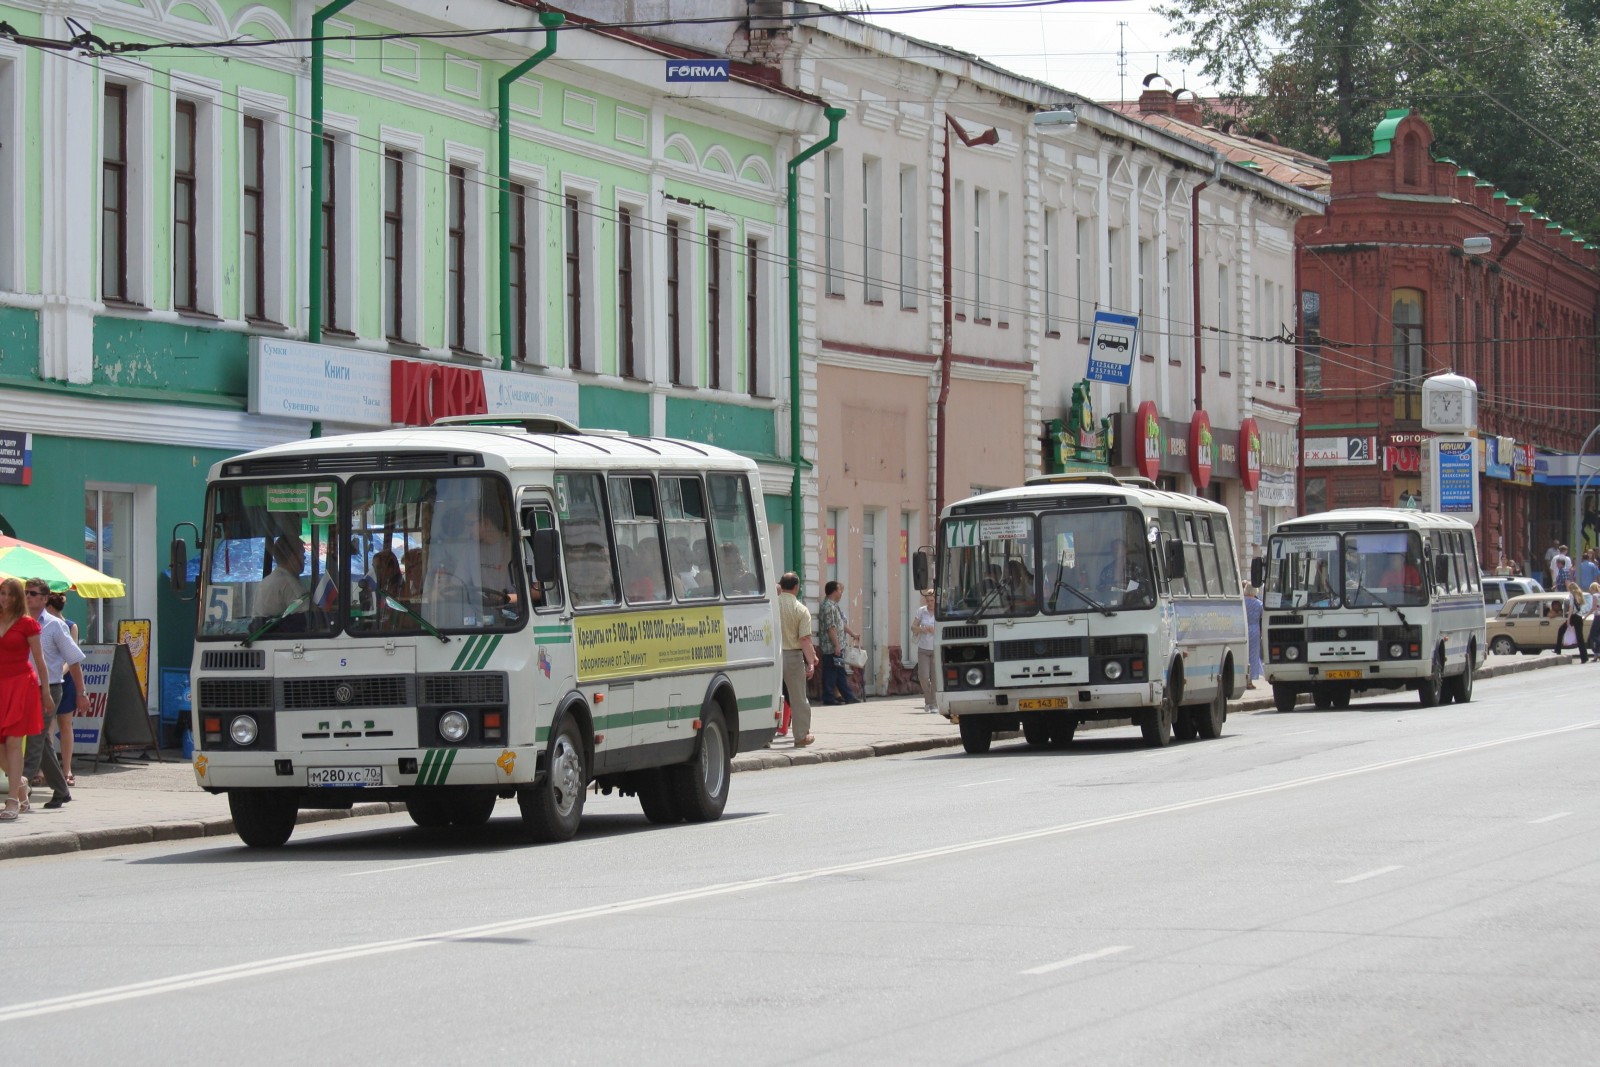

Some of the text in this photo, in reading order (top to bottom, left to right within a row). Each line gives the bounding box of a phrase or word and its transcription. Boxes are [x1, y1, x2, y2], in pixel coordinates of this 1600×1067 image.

[668, 65, 727, 77] FORMA
[263, 343, 287, 355] Сумки
[324, 359, 351, 381] Книги
[362, 395, 381, 407] Часы
[393, 359, 489, 426] ИСКРА
[283, 398, 320, 414] Сувениры
[1349, 438, 1363, 460] 2
[312, 486, 334, 517] 5
[556, 482, 567, 512] 5
[1272, 540, 1284, 559] 7
[208, 588, 229, 624] 5
[1294, 594, 1302, 607] 7
[577, 627, 604, 650] Кредиты
[605, 628, 612, 643] от
[612, 623, 617, 642] 5
[629, 626, 638, 644] до
[664, 617, 686, 641] рублей
[699, 620, 706, 638] до
[706, 616, 711, 634] 5
[711, 620, 720, 634] лет
[727, 625, 764, 644] УРСА Банк
[340, 658, 347, 667] 5
[580, 656, 614, 672] оформление
[615, 656, 622, 666] от
[622, 651, 631, 666] 30
[631, 653, 647, 666] минут
